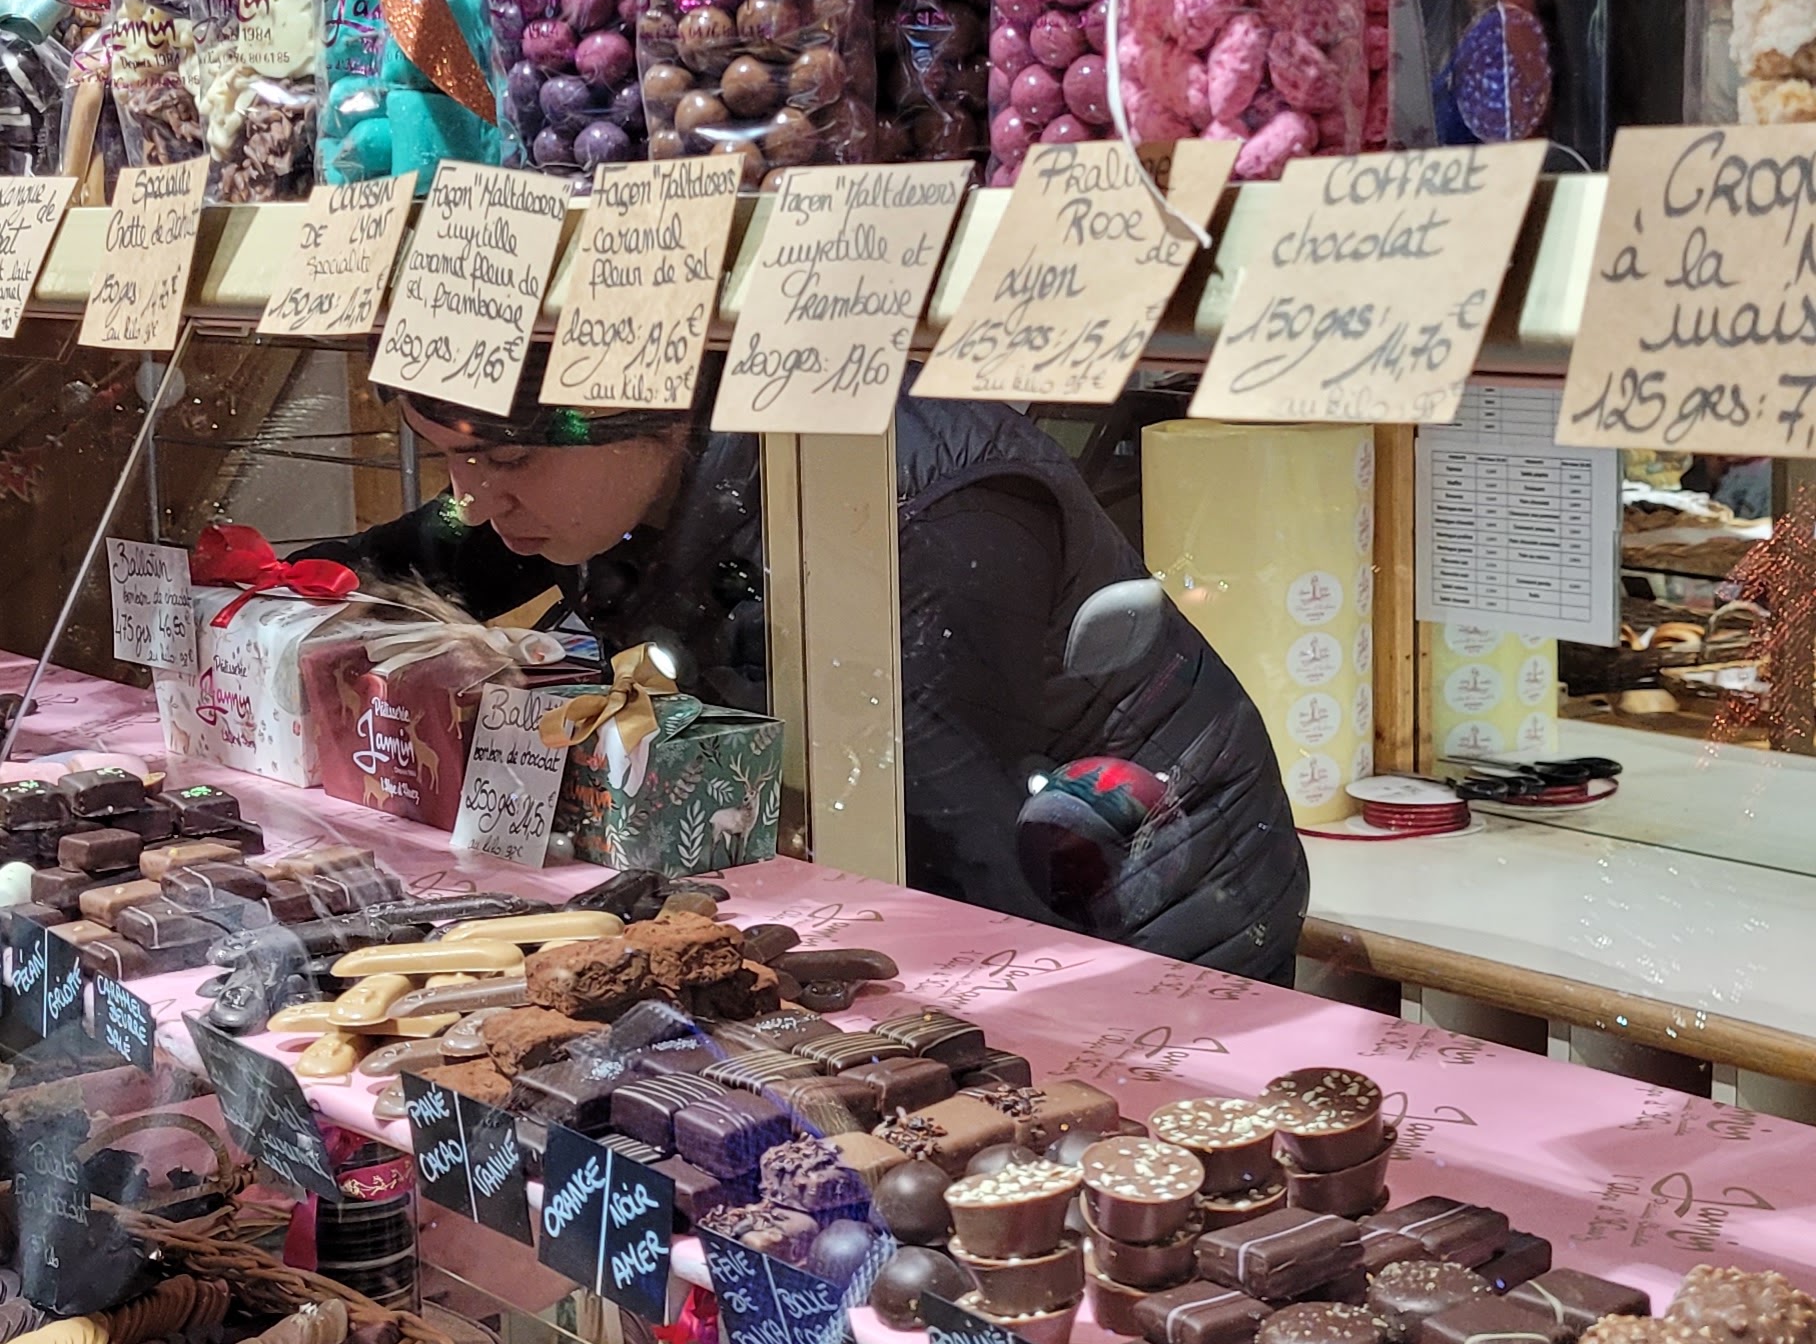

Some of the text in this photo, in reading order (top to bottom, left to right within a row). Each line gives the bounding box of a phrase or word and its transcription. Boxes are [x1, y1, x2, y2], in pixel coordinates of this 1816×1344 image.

[593, 165, 652, 217] Façon
[779, 170, 834, 226] Façon
[1322, 146, 1489, 206] Coffret
[1663, 130, 1816, 248] Croq
[300, 208, 395, 250] DE LYON
[901, 232, 935, 268] et
[1056, 197, 1185, 267] Rose de
[1271, 208, 1451, 269] chocolat
[518, 264, 540, 300] de
[589, 257, 643, 301] fleur
[652, 256, 676, 287] de
[1664, 226, 1742, 291] la
[430, 282, 525, 333] framboise
[353, 708, 415, 775] Jannin
[96, 974, 148, 1024] CARAMEL
[419, 1139, 466, 1183] CACAO
[472, 1127, 520, 1198] VANILLE
[543, 1155, 607, 1238] ORANGE
[608, 1181, 660, 1229] NOIR
[1650, 1171, 1777, 1253] Jannin
[610, 1229, 670, 1290] AMER
[723, 1287, 760, 1314] DE
